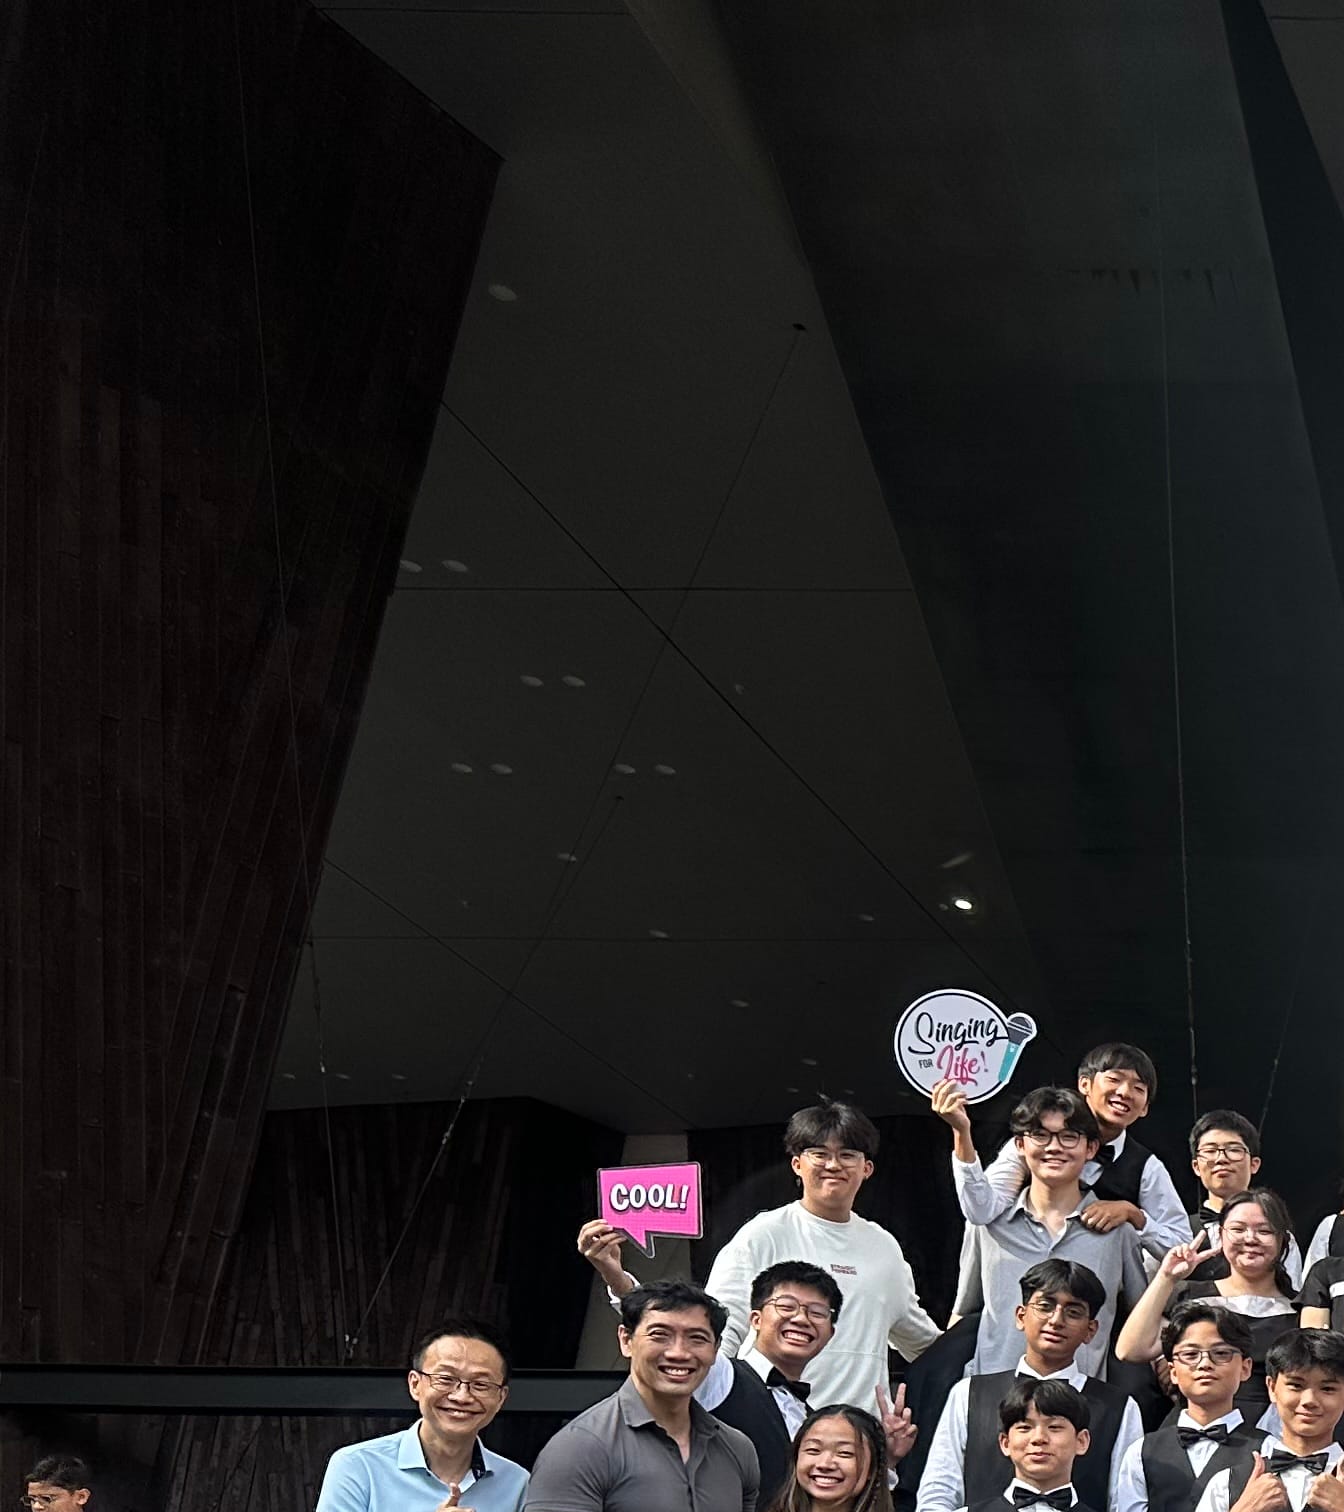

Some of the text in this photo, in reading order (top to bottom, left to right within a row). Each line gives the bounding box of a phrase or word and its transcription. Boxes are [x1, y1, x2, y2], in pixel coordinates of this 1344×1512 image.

[908, 1012, 1008, 1055] Singing
[918, 1045, 989, 1086] FOR Life!
[609, 1183, 690, 1212] COOL!
